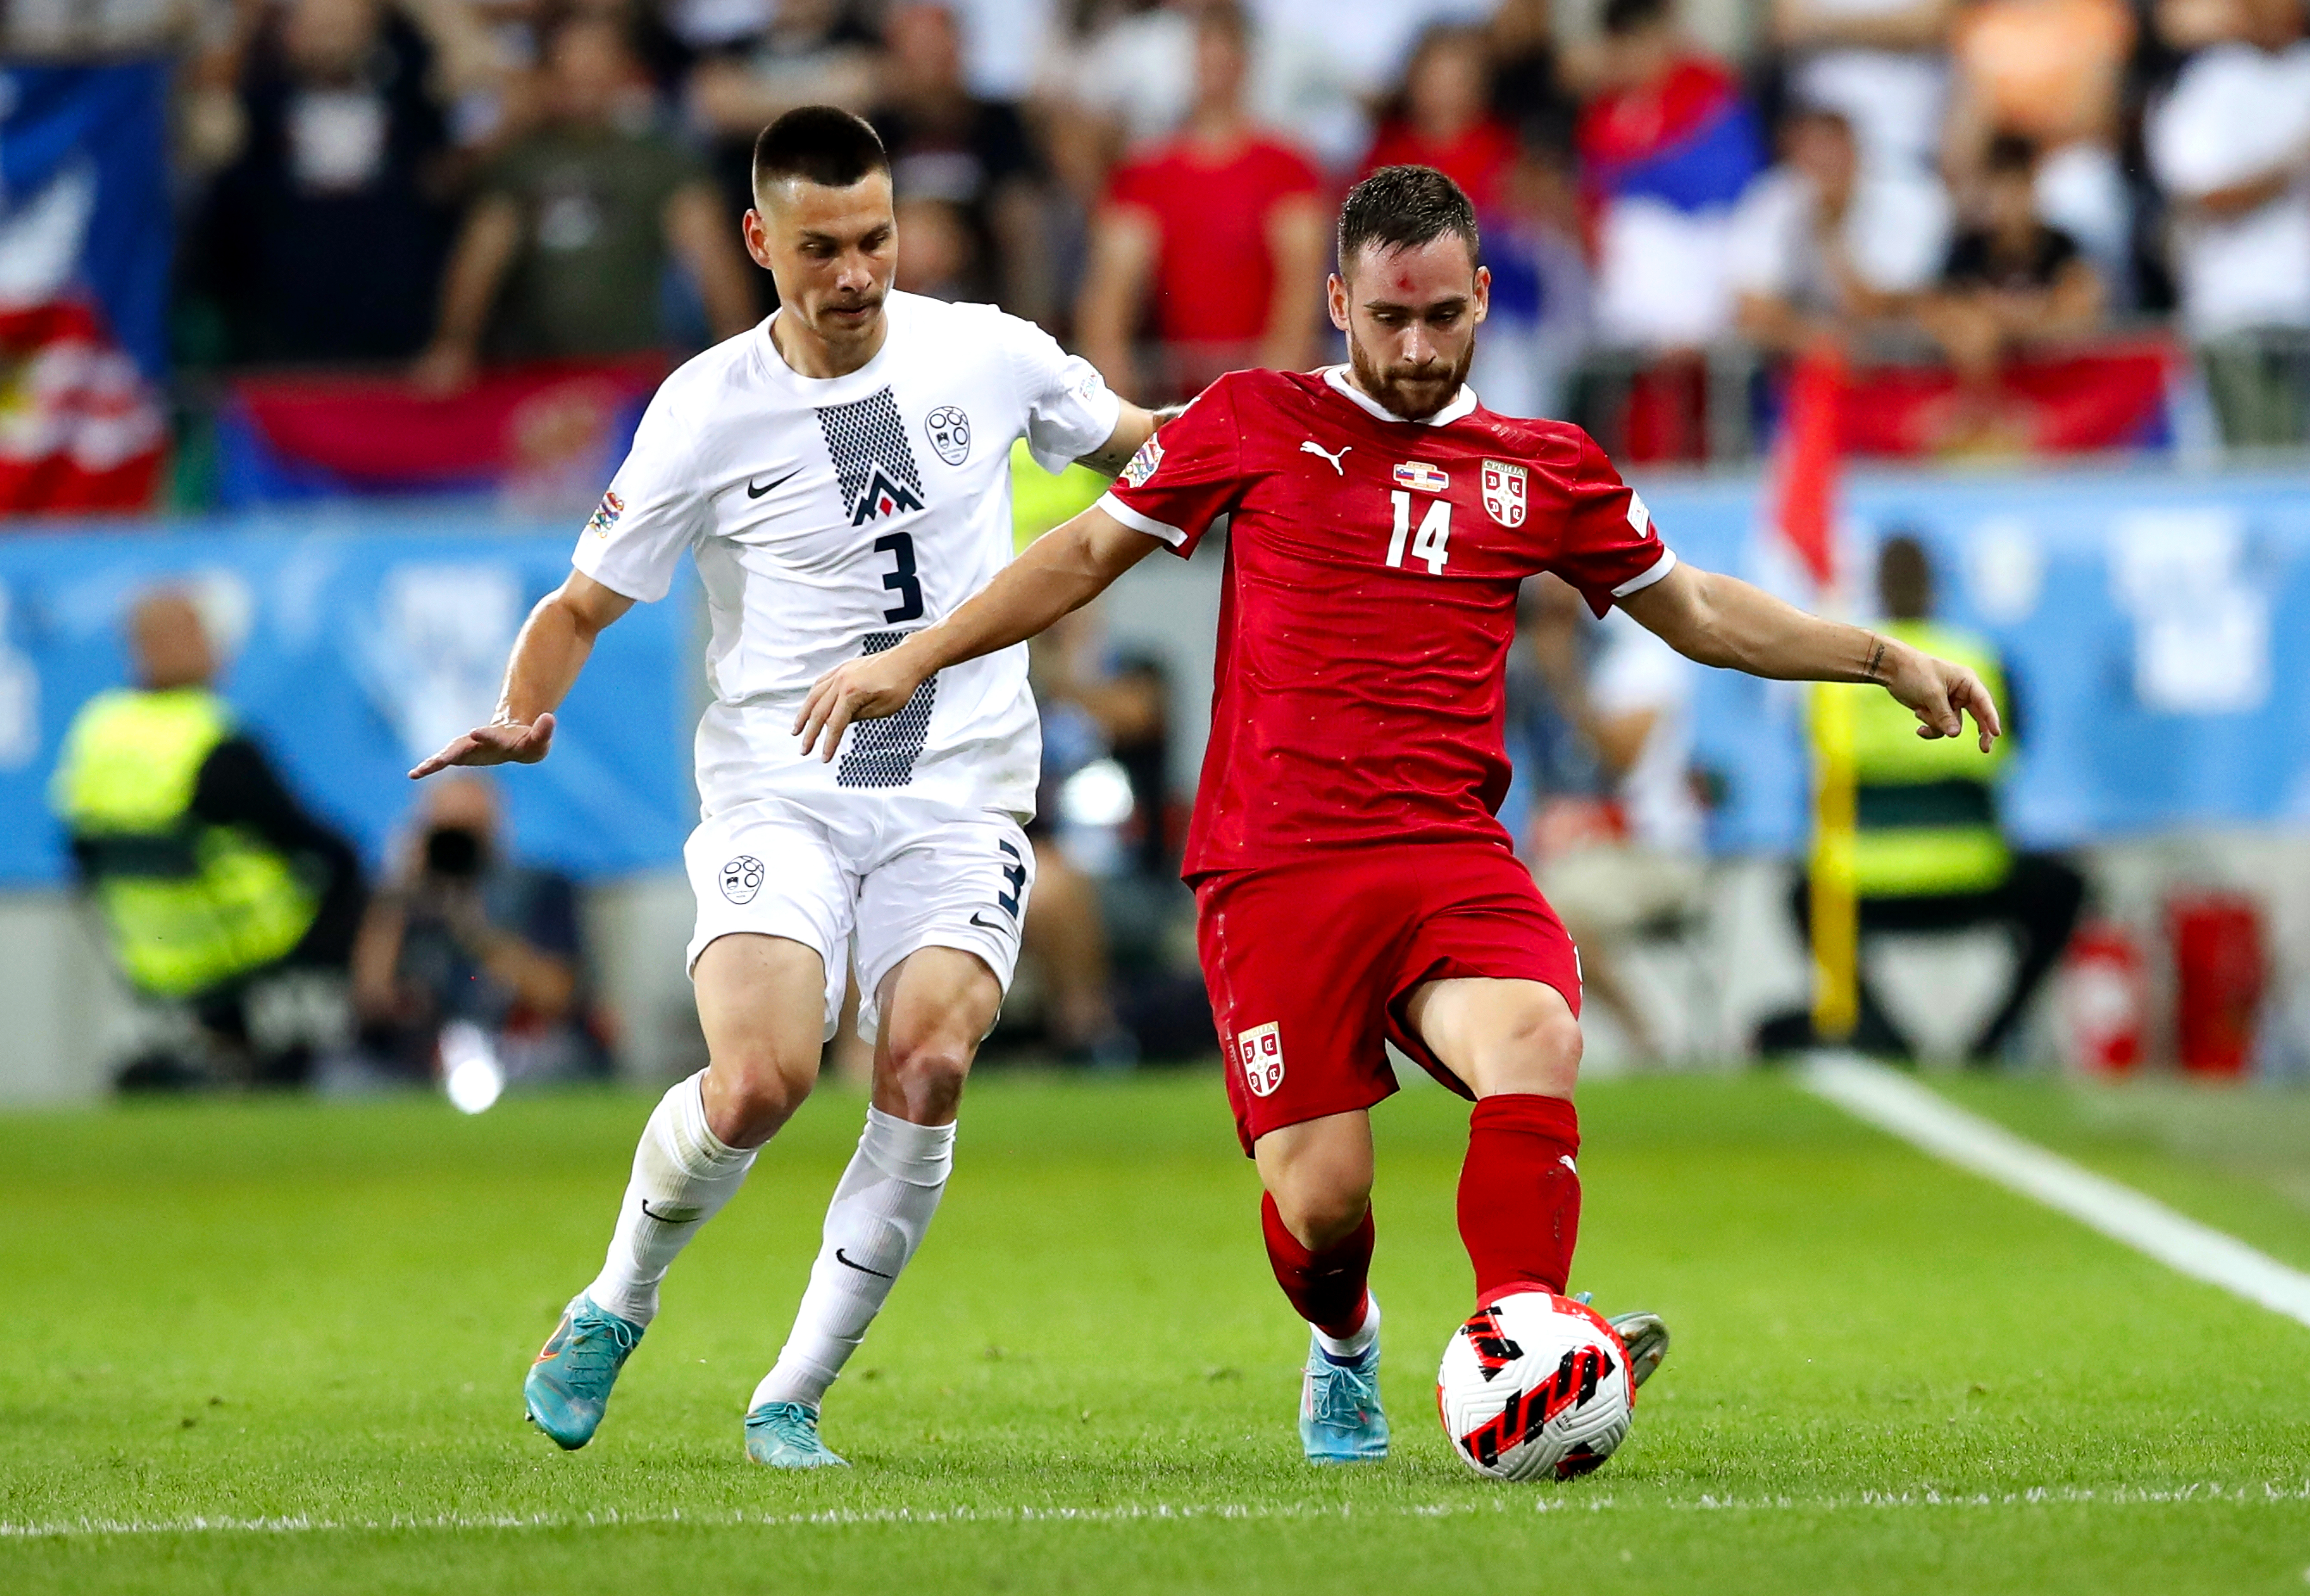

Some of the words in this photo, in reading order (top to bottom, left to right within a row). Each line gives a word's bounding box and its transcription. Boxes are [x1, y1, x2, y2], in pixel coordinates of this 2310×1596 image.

[1484, 461, 1525, 476] СРБИЈА
[1386, 490, 1452, 576] 14
[874, 532, 924, 624] 3
[999, 838, 1026, 921] 3
